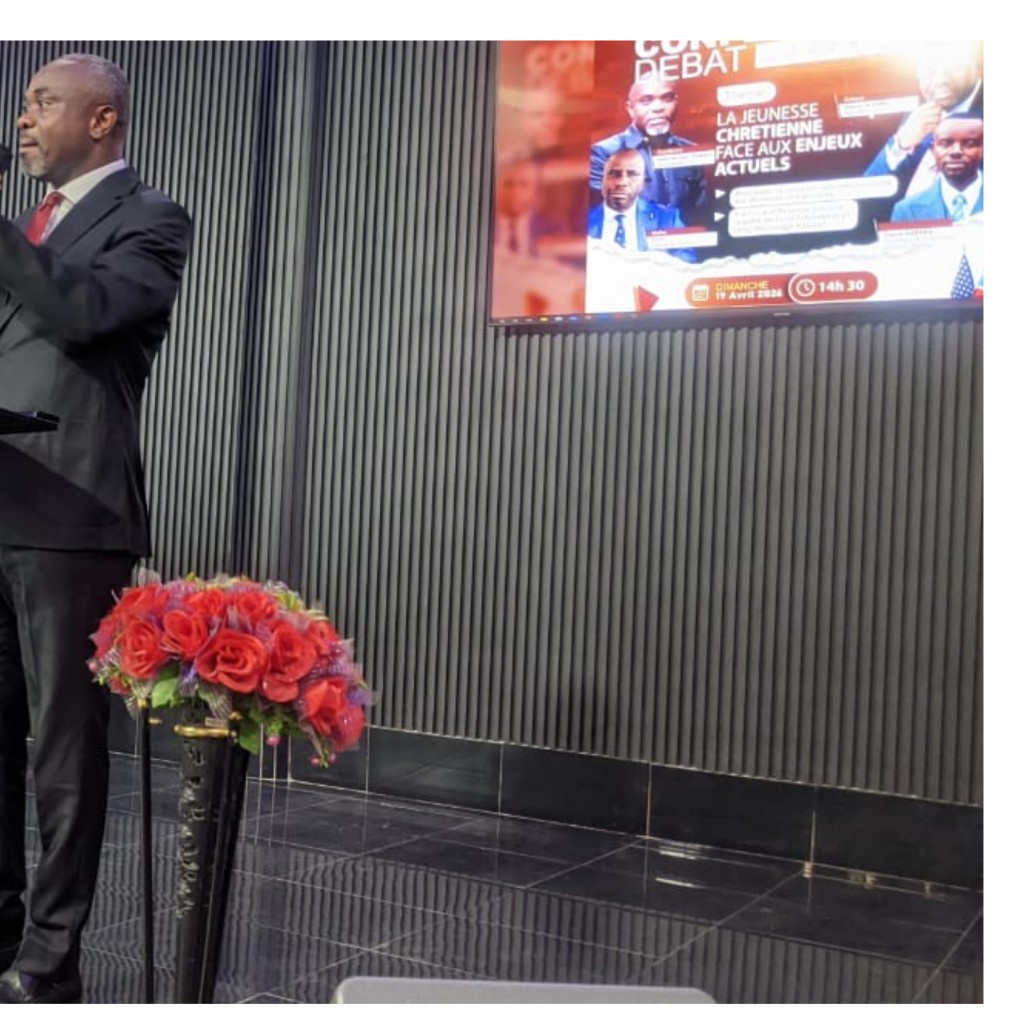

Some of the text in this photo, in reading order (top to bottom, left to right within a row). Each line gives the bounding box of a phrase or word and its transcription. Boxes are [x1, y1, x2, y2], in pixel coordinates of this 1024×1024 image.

[635, 44, 747, 83] DEBAT
[716, 102, 820, 127] LA JEUNESSE
[715, 119, 824, 143] CHRETIENNE
[715, 142, 754, 160] FACE
[757, 139, 792, 157] AUX
[795, 132, 863, 154] ENJEUX
[714, 156, 791, 177] ACTUELS
[715, 280, 769, 292] DIMANCHE
[729, 289, 755, 300] Avril
[819, 279, 866, 293] 14h 30
